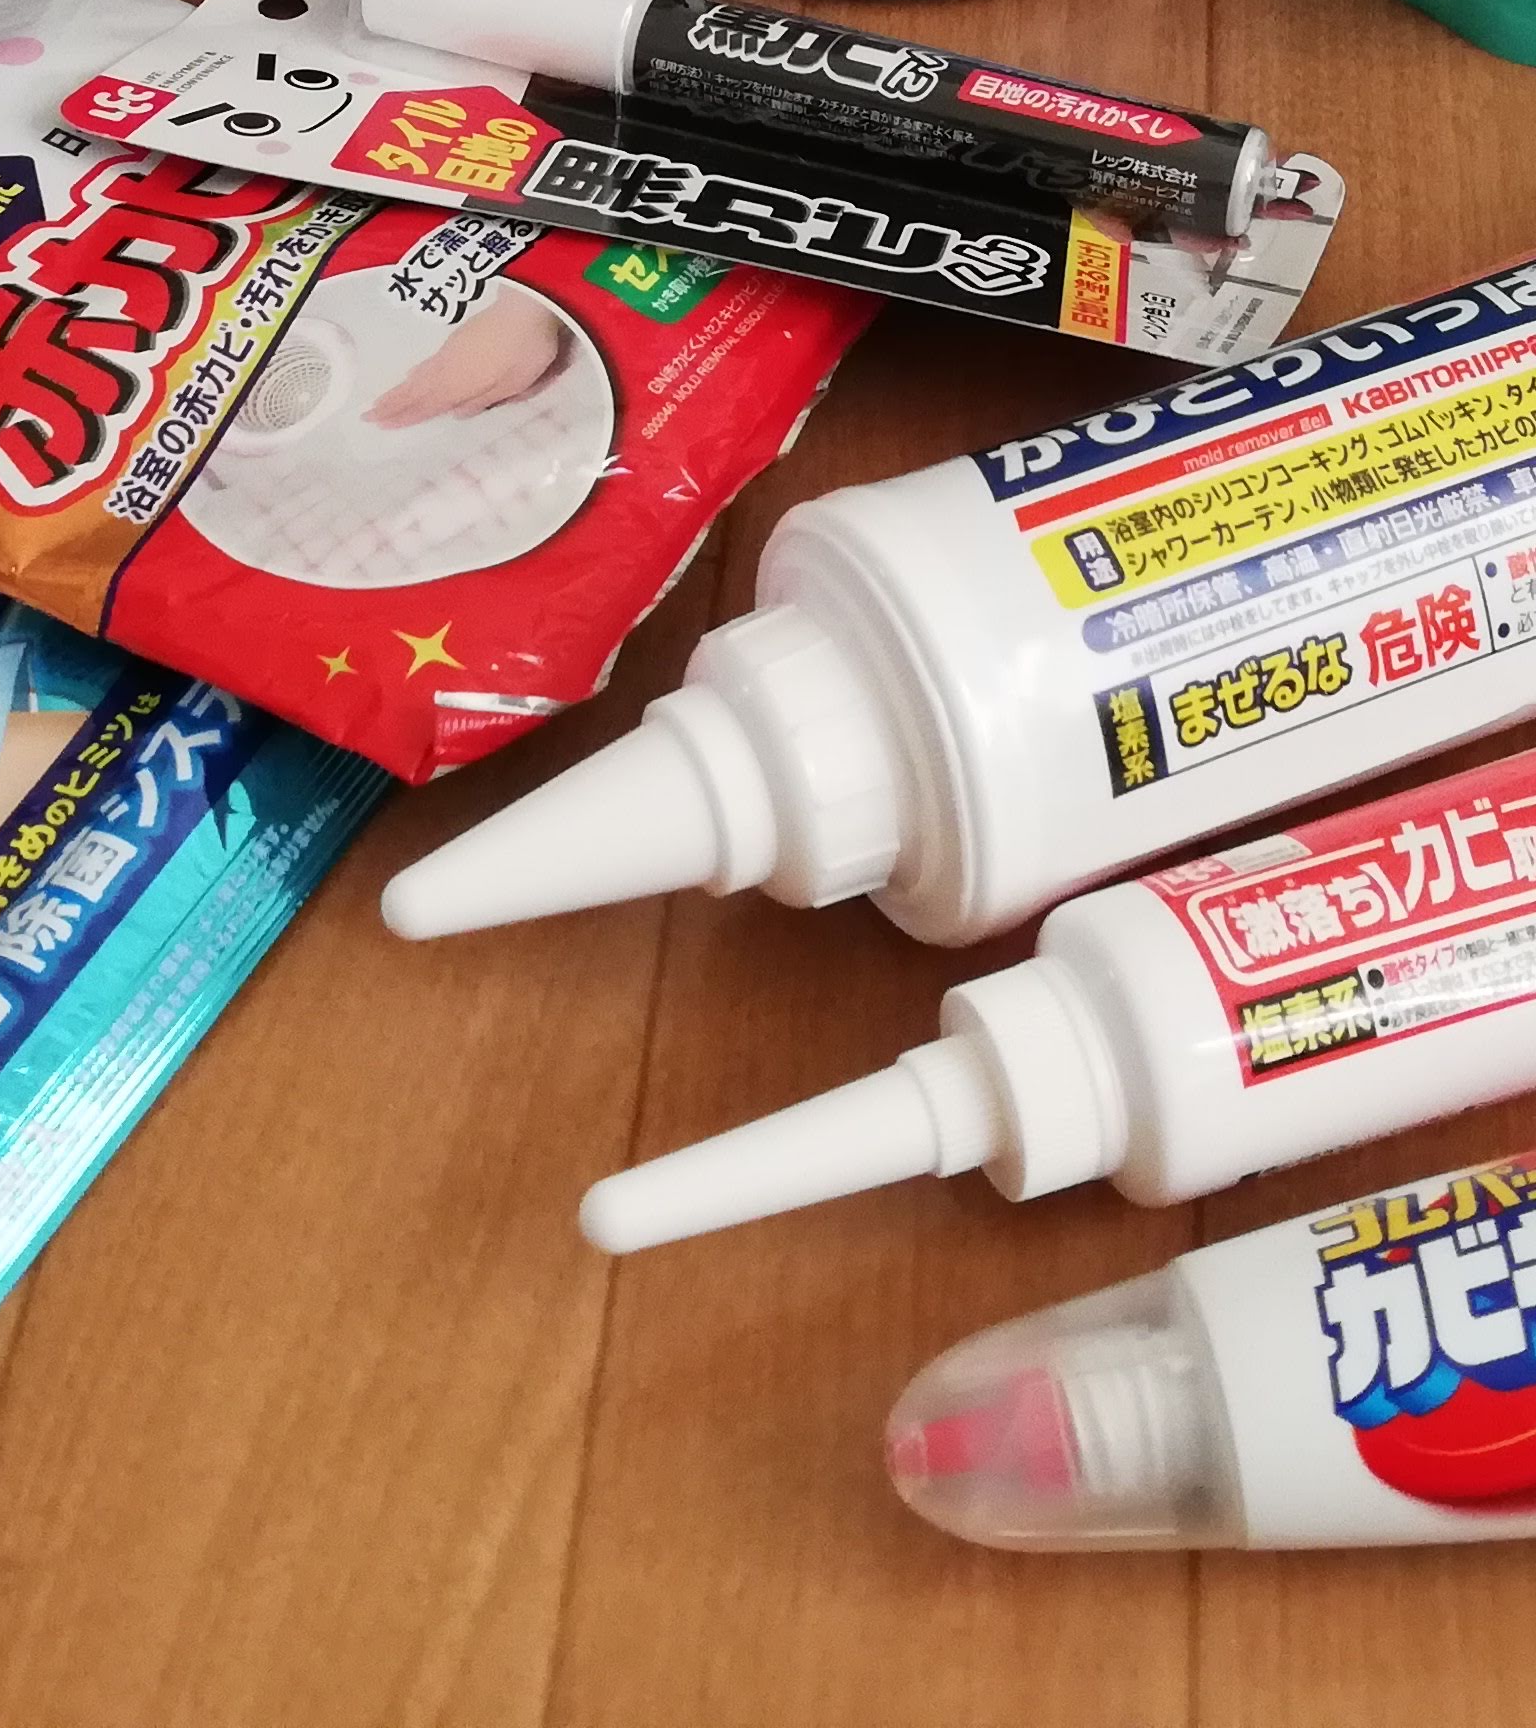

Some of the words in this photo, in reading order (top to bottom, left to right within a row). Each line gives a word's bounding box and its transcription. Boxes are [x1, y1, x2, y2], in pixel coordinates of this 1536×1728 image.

[88, 85, 156, 122] LEC
[364, 95, 468, 174] タイル
[969, 75, 1174, 140] 目地の汚れかくし
[435, 114, 542, 193] 目地の
[1091, 148, 1199, 189] レック株式会社
[525, 139, 1052, 297] 黒カビくん
[696, 335, 740, 377] REMOVAL
[1227, 425, 1295, 456] remover
[1171, 633, 1352, 749] まぜるな
[1359, 587, 1484, 689] 危険
[1105, 688, 1158, 785] 塩素系
[1241, 977, 1374, 1065] 塩素系
